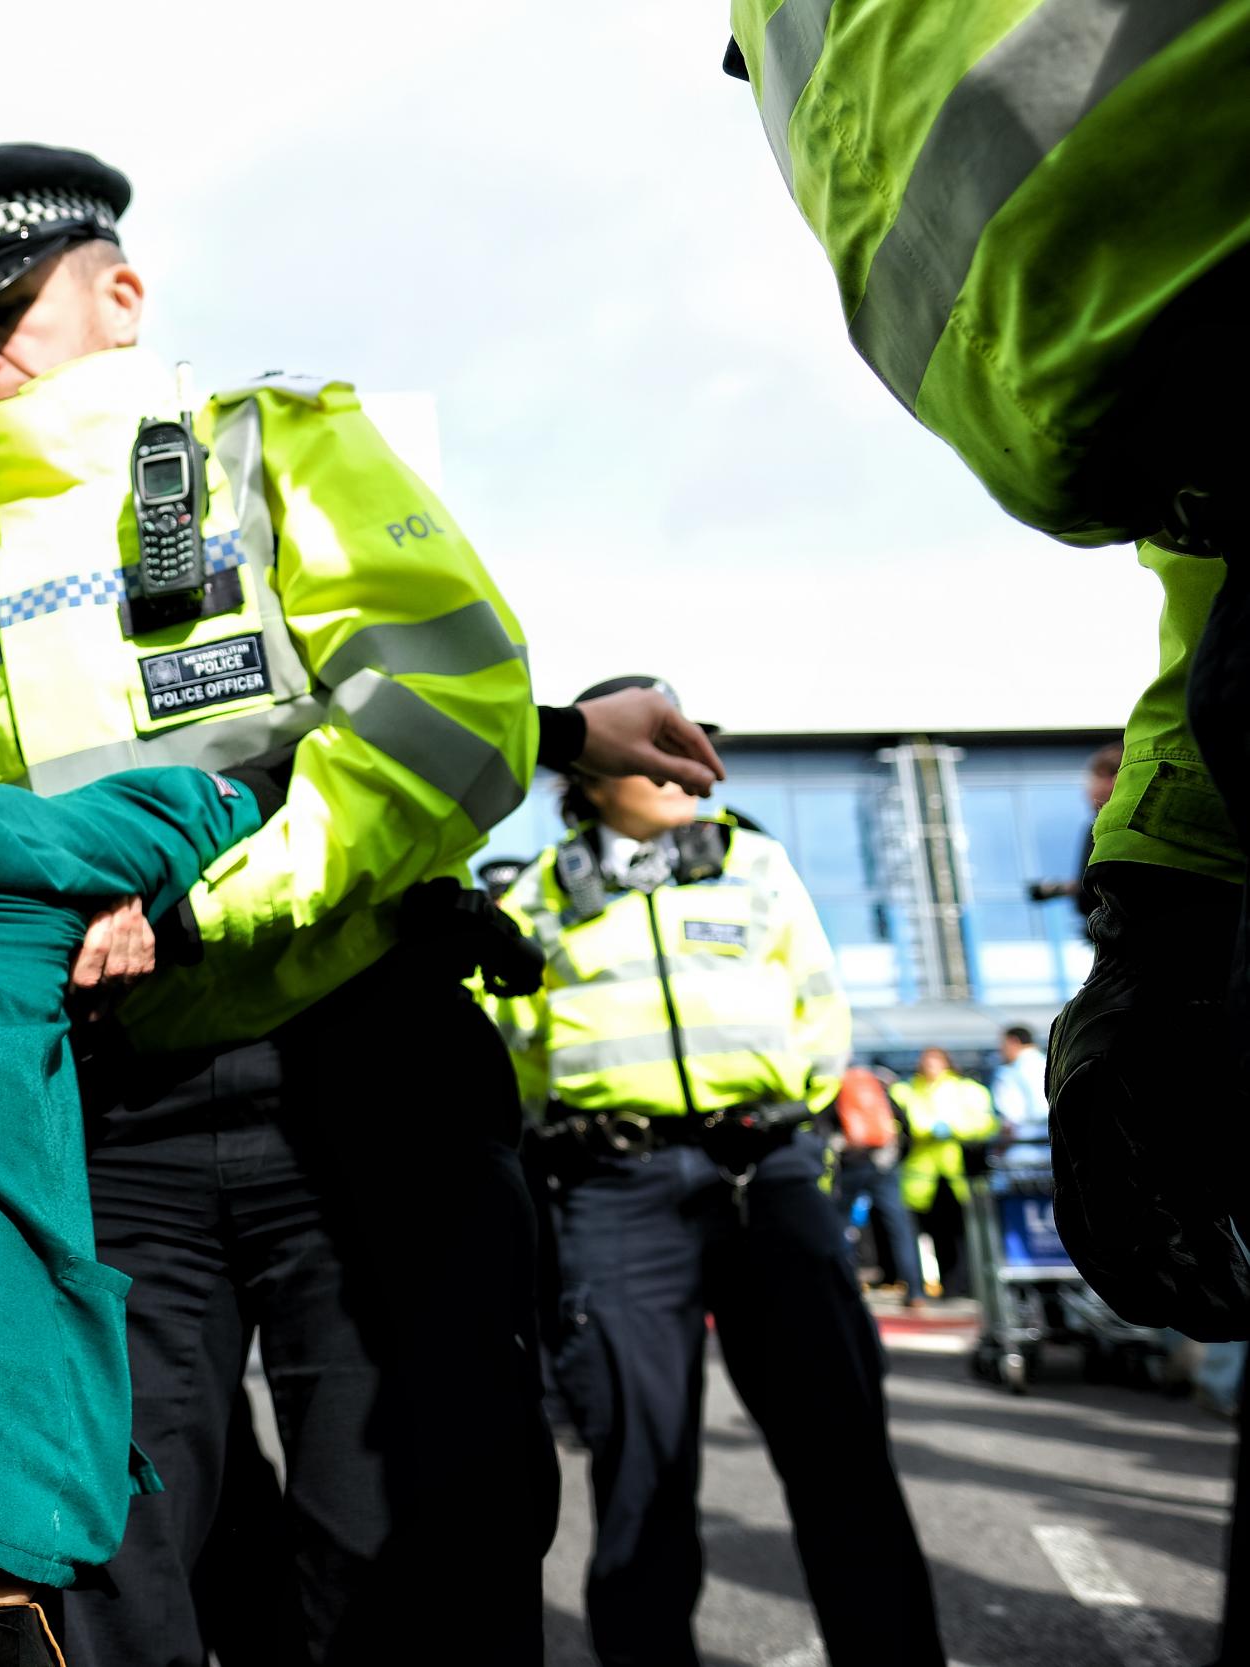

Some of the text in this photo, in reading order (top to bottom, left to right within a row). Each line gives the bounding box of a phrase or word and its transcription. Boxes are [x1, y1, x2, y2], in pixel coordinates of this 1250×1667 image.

[183, 644, 249, 664] METROPOLITAN
[195, 654, 243, 676] POLICE
[152, 674, 264, 709] POLICE OFFICER
